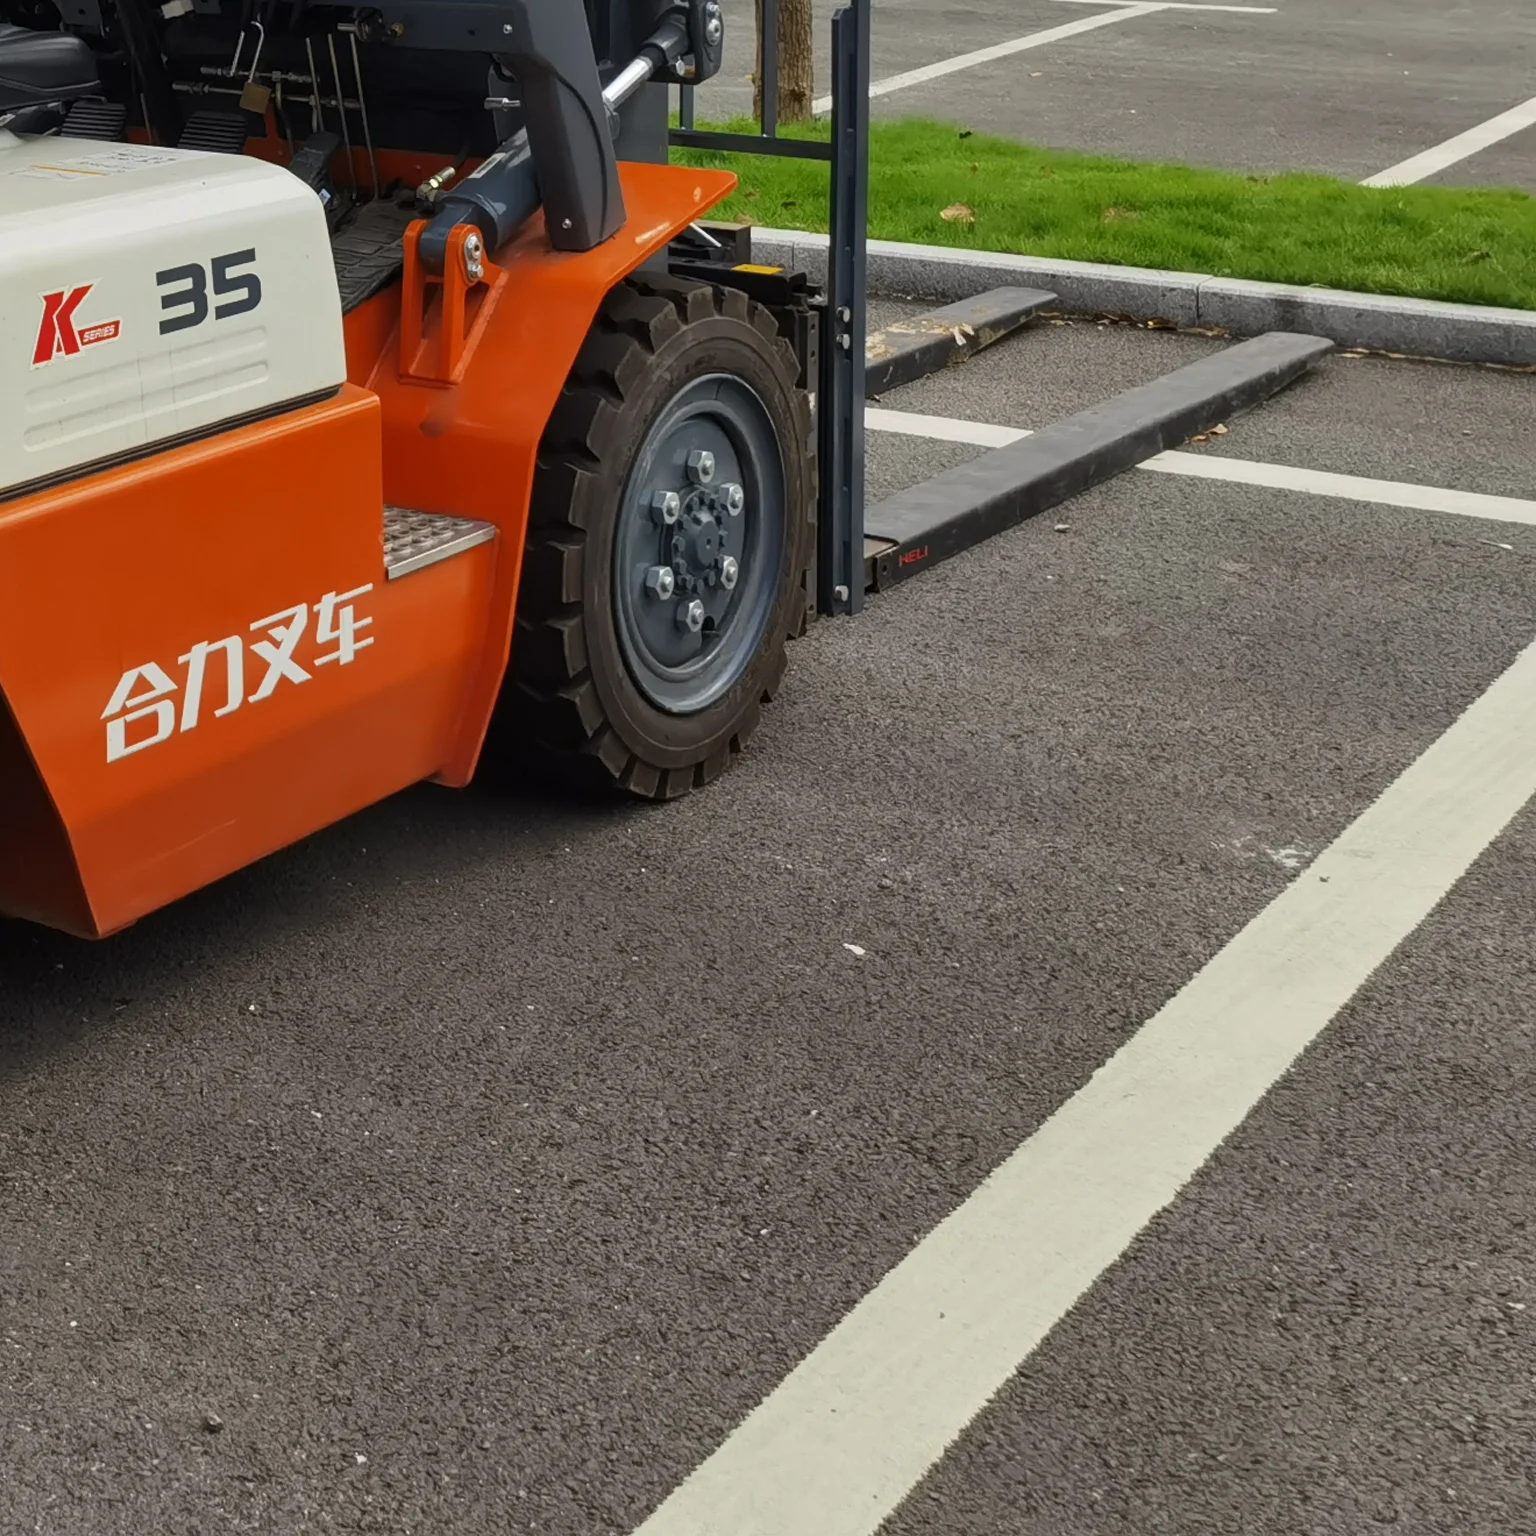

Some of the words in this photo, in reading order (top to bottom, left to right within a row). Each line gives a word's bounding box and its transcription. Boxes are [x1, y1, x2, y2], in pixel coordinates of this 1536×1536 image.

[31, 283, 95, 365] K
[82, 323, 116, 343] SERIES
[155, 248, 263, 335] 35
[898, 545, 931, 568] HELI
[100, 582, 375, 763] 合力叉车
